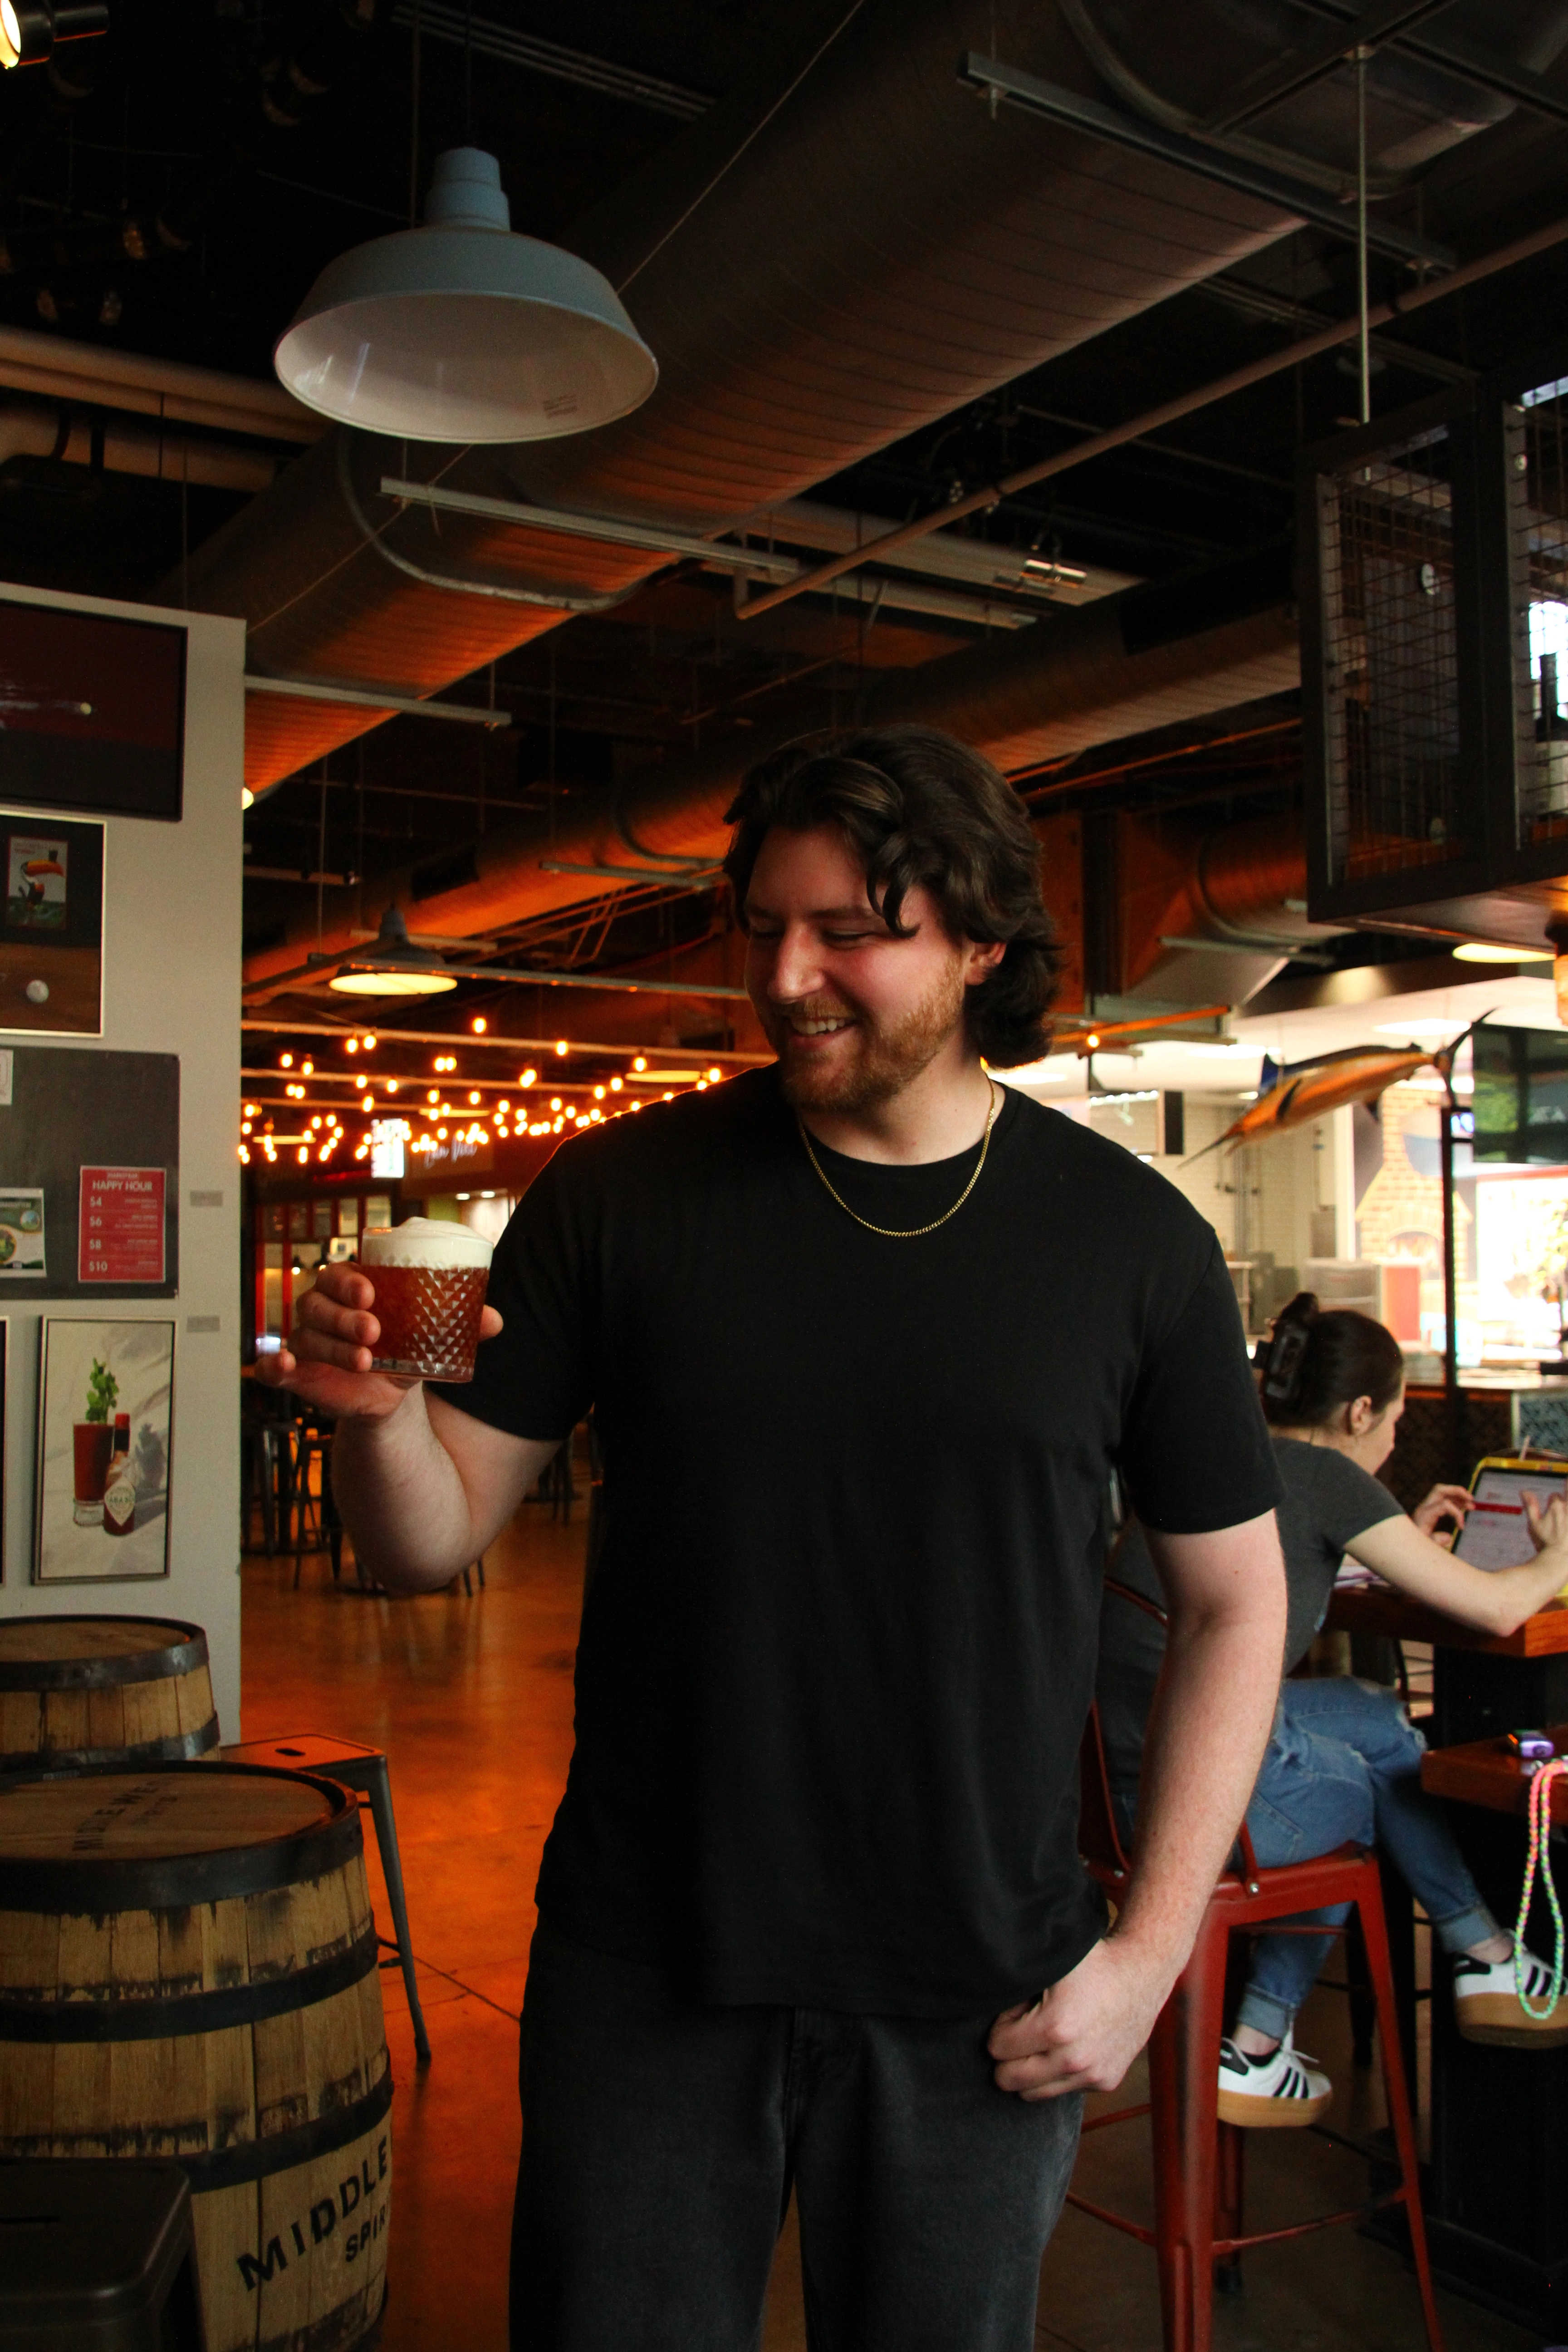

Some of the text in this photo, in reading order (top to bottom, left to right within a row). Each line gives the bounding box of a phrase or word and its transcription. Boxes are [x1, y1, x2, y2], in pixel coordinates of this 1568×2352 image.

[92, 1180, 152, 1192] HAPPY HOUR
[90, 1196, 102, 1207] $4
[89, 1216, 102, 1227] $6
[89, 1239, 102, 1250] $8
[89, 1260, 108, 1272] $10
[236, 2135, 387, 2292] MIDDLE
